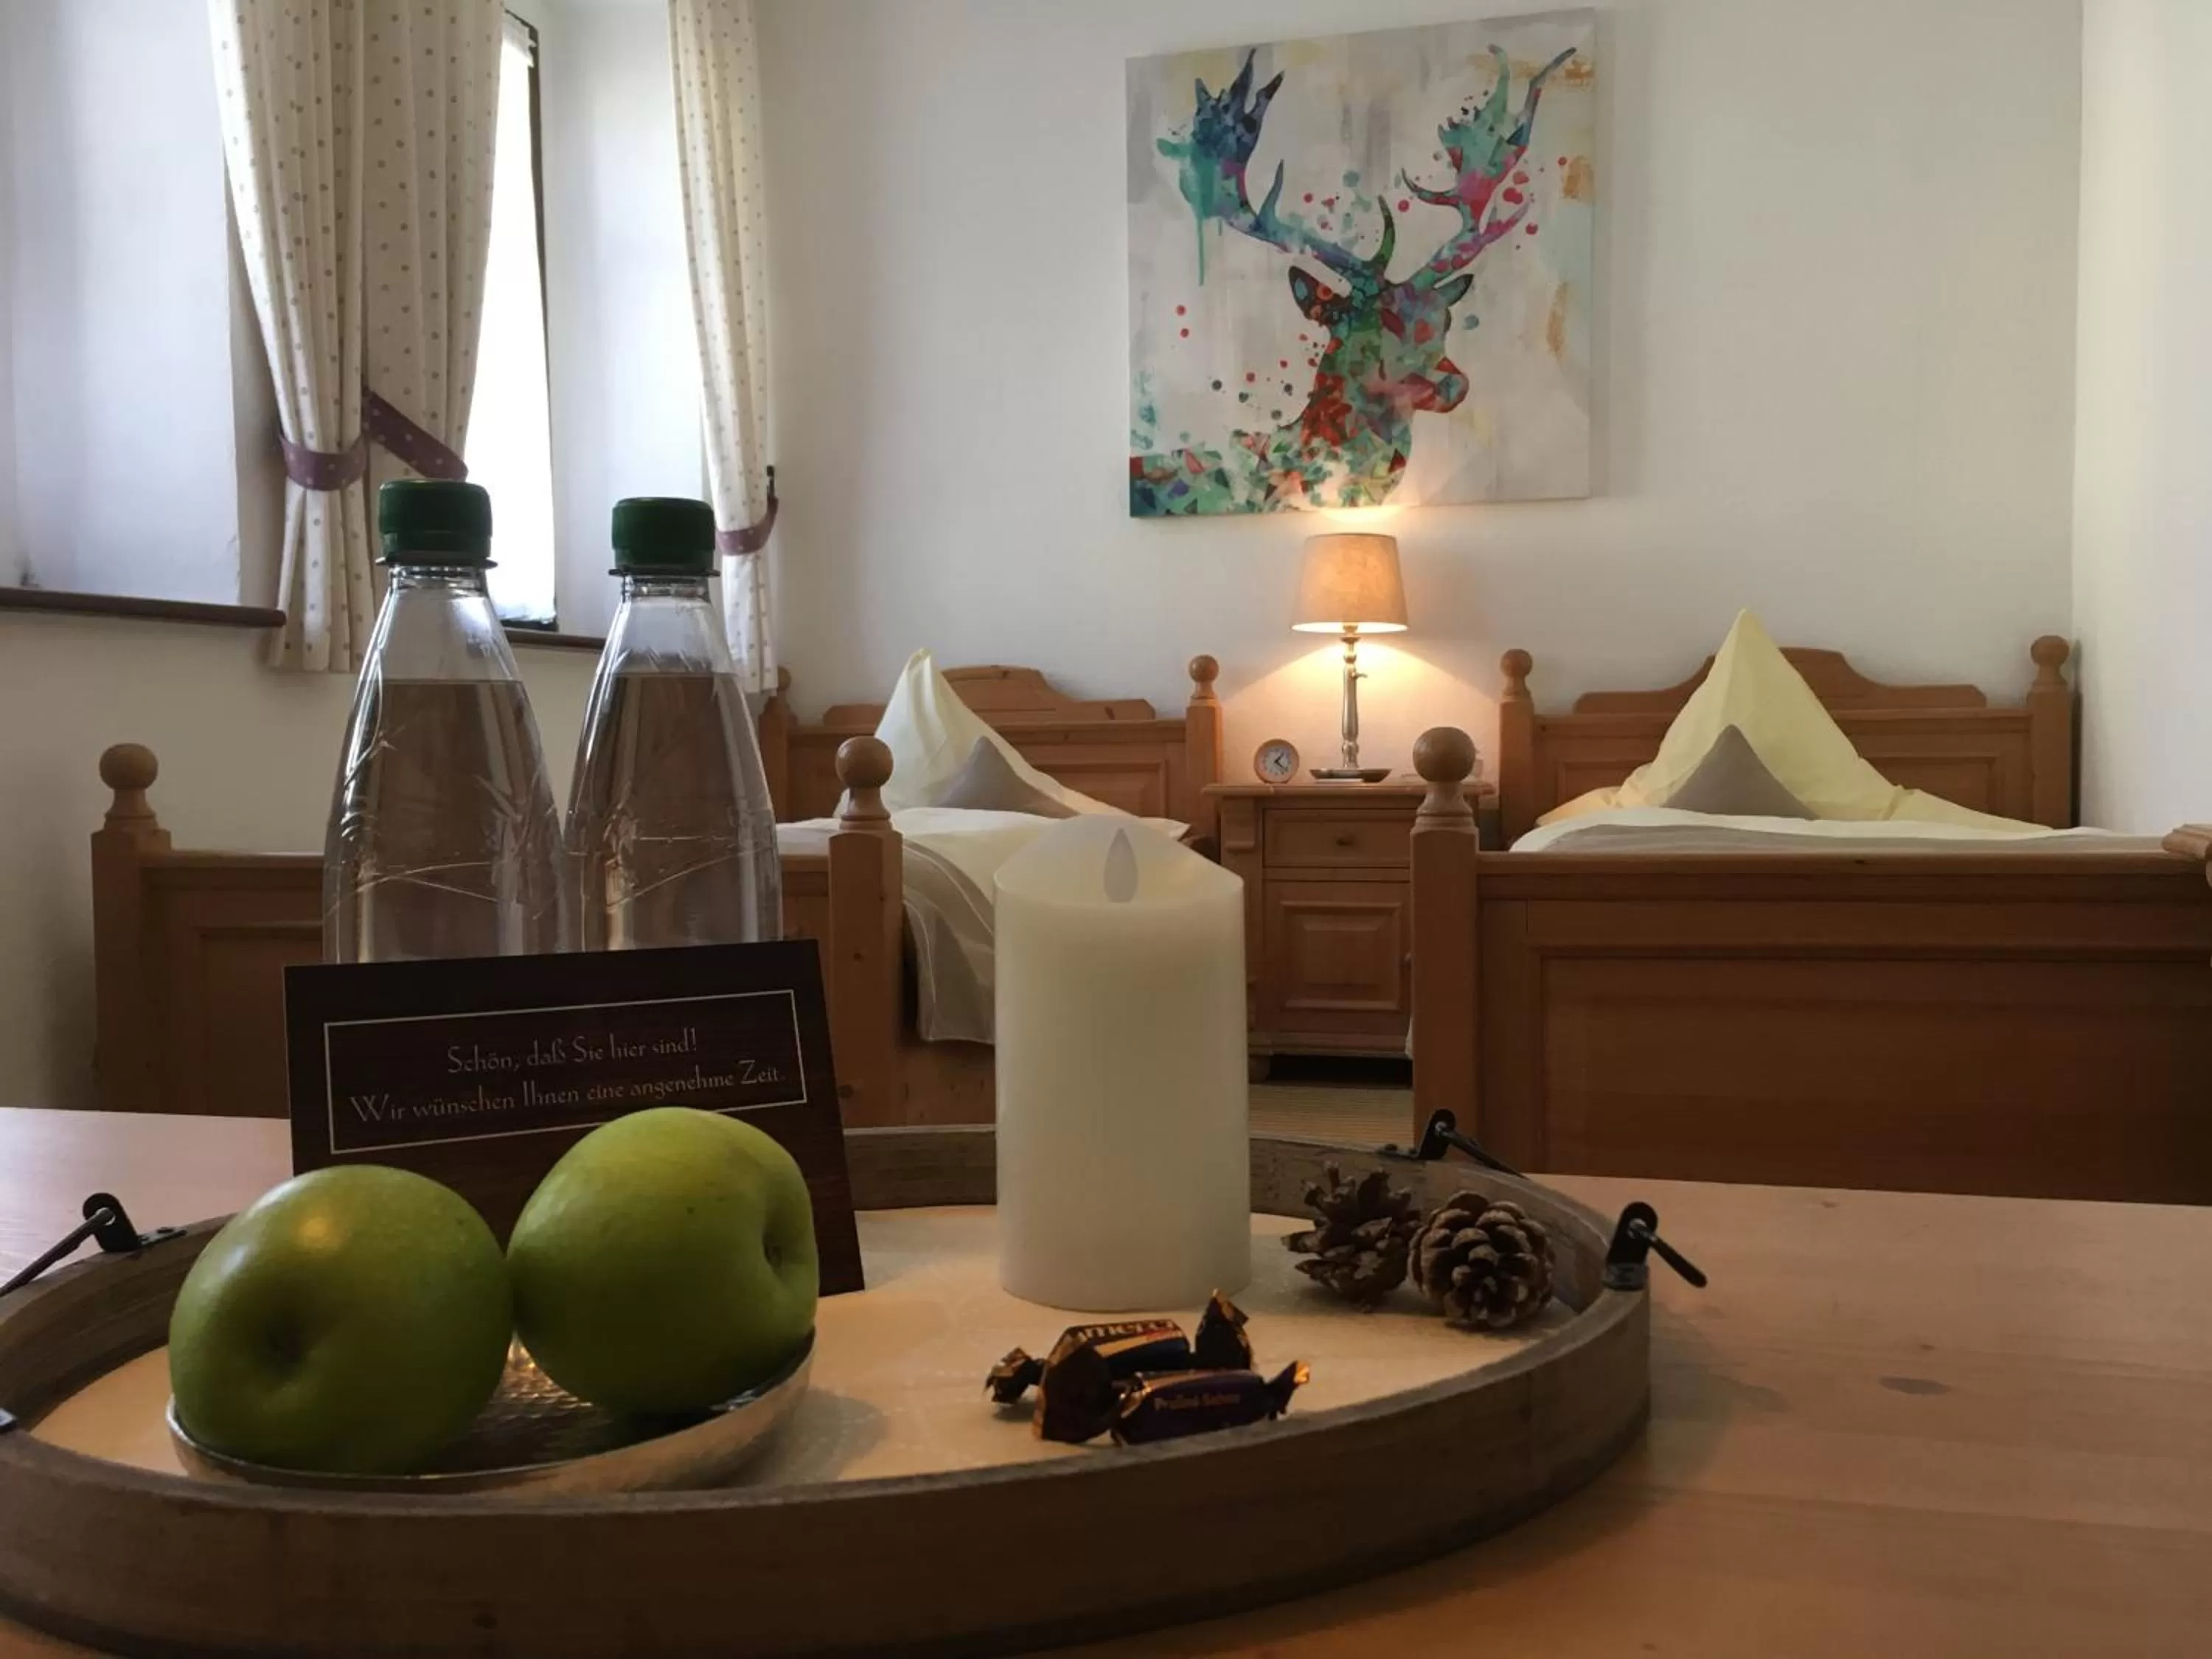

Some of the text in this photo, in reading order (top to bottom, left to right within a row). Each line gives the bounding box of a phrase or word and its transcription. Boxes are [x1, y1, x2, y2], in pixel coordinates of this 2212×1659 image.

[526, 1037, 567, 1066] daß
[571, 1035, 604, 1062] Sie
[608, 1032, 646, 1060] hier
[652, 1026, 697, 1054] sind!
[349, 1093, 408, 1121] Wir
[413, 1085, 515, 1118] wünschen
[522, 1079, 579, 1107] Ihnen
[586, 1085, 624, 1100] eine
[630, 1064, 734, 1099] angenehme
